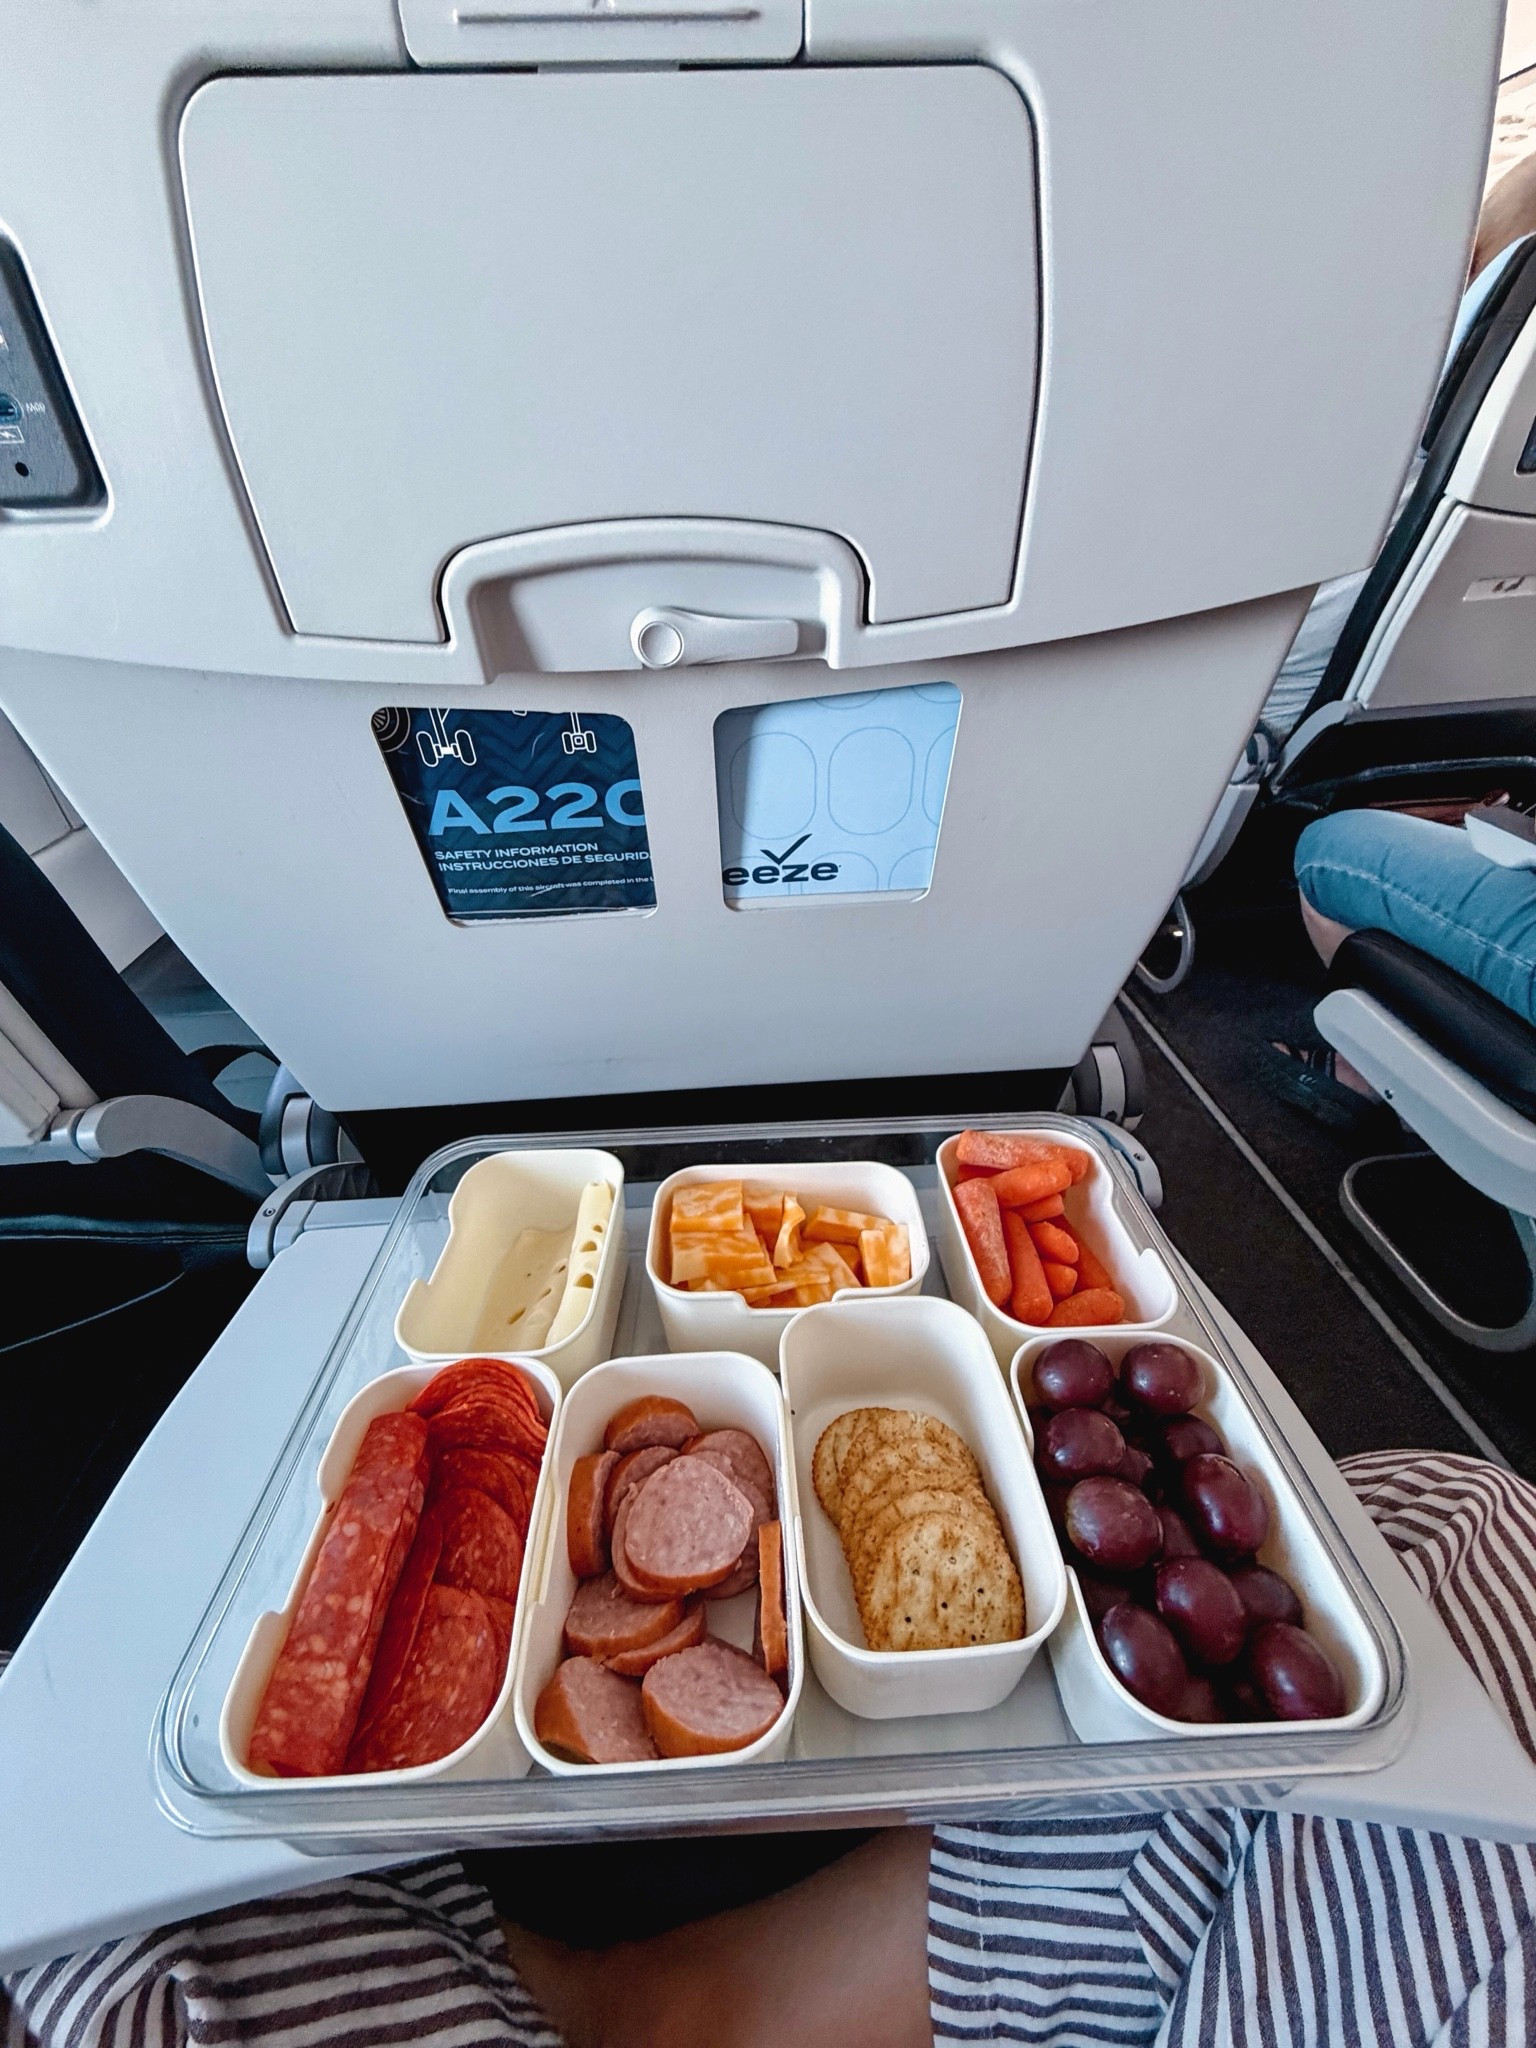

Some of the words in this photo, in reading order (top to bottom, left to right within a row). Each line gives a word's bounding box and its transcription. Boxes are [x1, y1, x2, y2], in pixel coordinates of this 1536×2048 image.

[434, 849, 492, 860] SAFETY
[495, 843, 598, 858] INFORMATION
[438, 857, 559, 871] INSTRUCCIONES
[561, 855, 583, 865] DE
[584, 851, 652, 864] SEGURID
[722, 862, 839, 885] eeze
[469, 886, 507, 894] assembly
[518, 884, 535, 892] this
